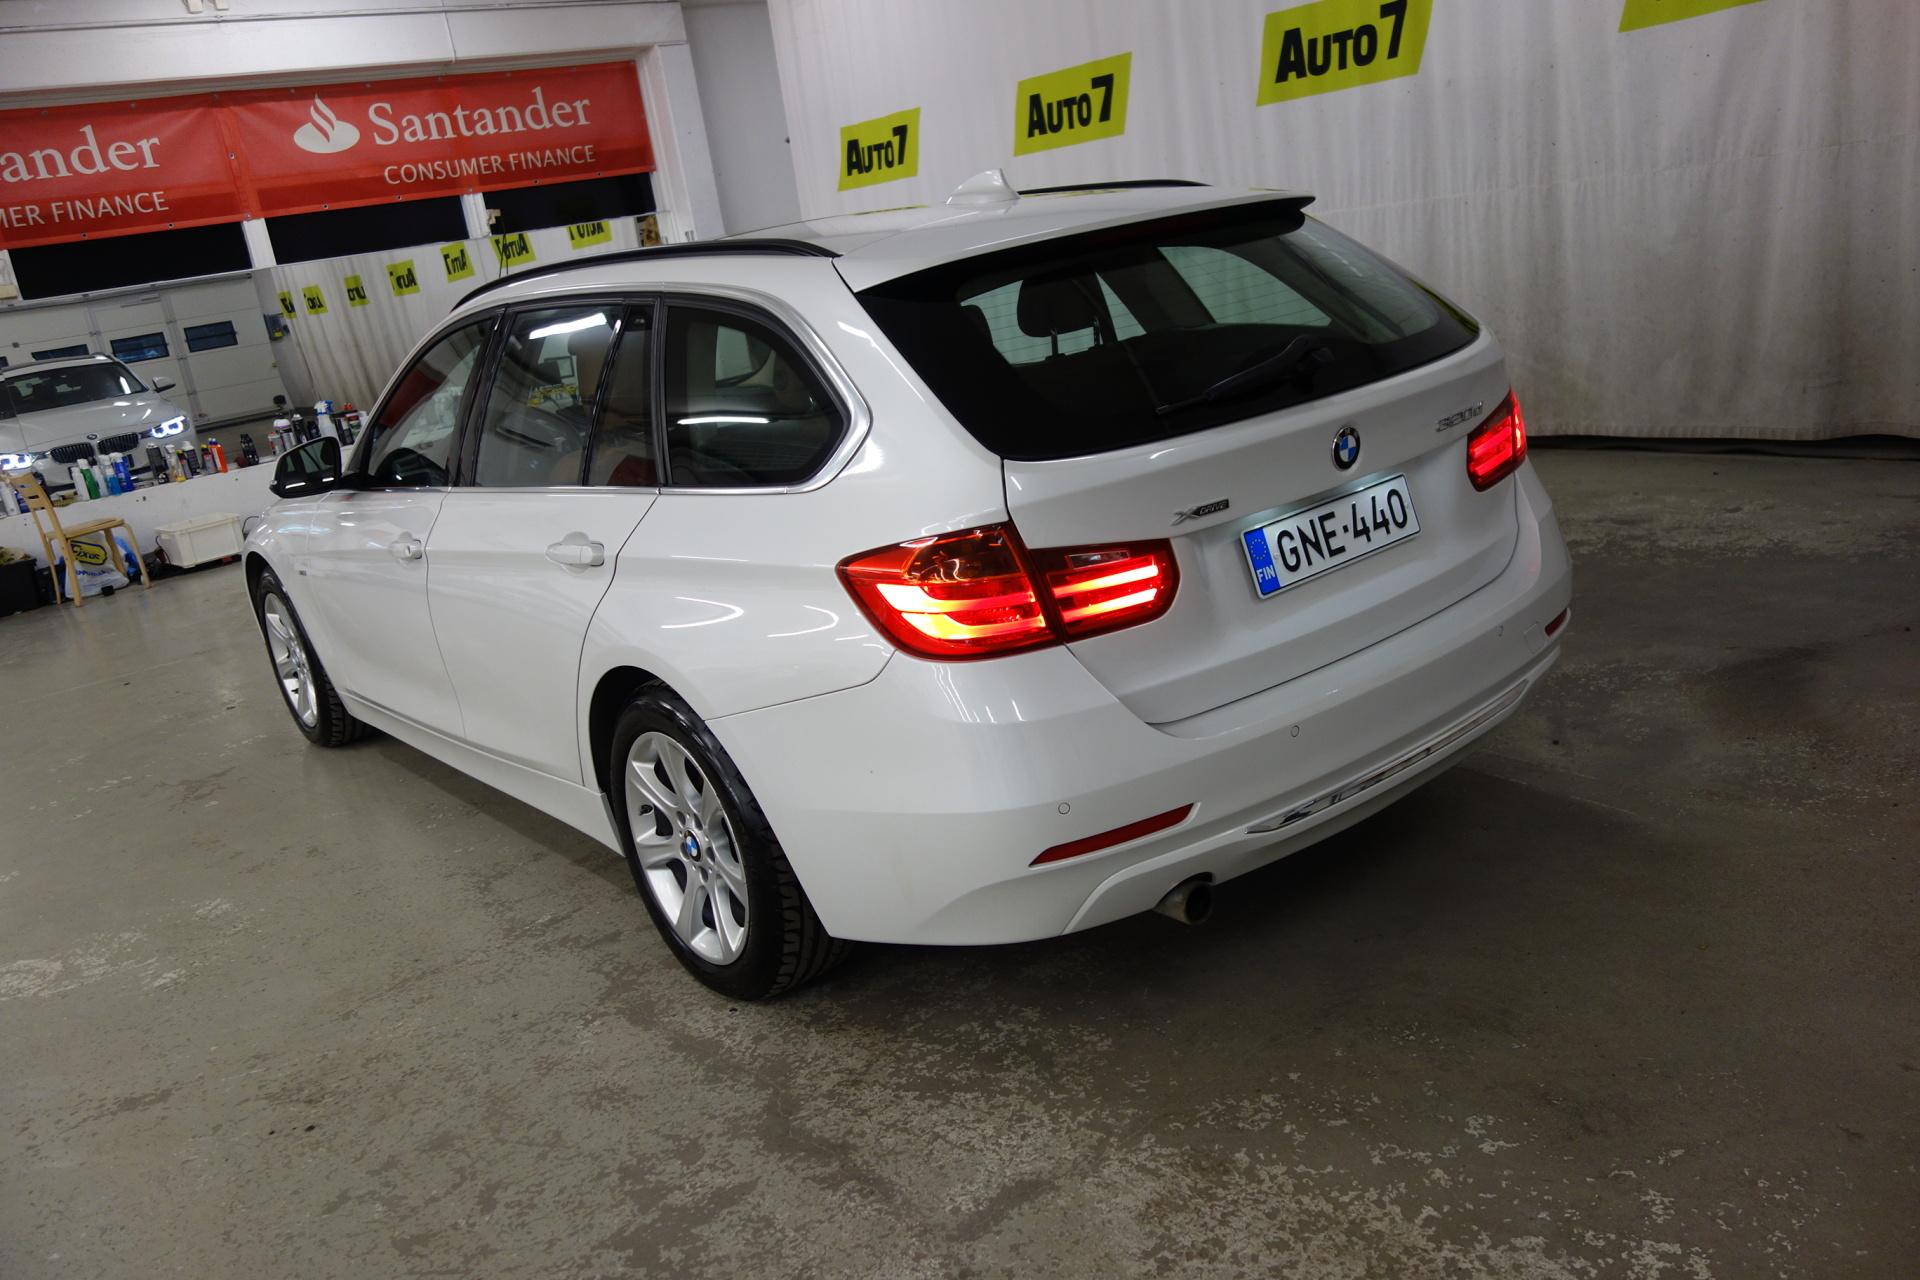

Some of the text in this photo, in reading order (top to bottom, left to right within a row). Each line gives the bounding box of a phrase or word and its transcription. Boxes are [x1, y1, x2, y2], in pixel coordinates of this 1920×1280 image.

[368, 86, 592, 145] Santander
[384, 144, 596, 185] CONSUMER FINANCE
[51, 191, 169, 223] FINANCE
[1436, 400, 1484, 433] 320d
[1256, 565, 1276, 583] FIN
